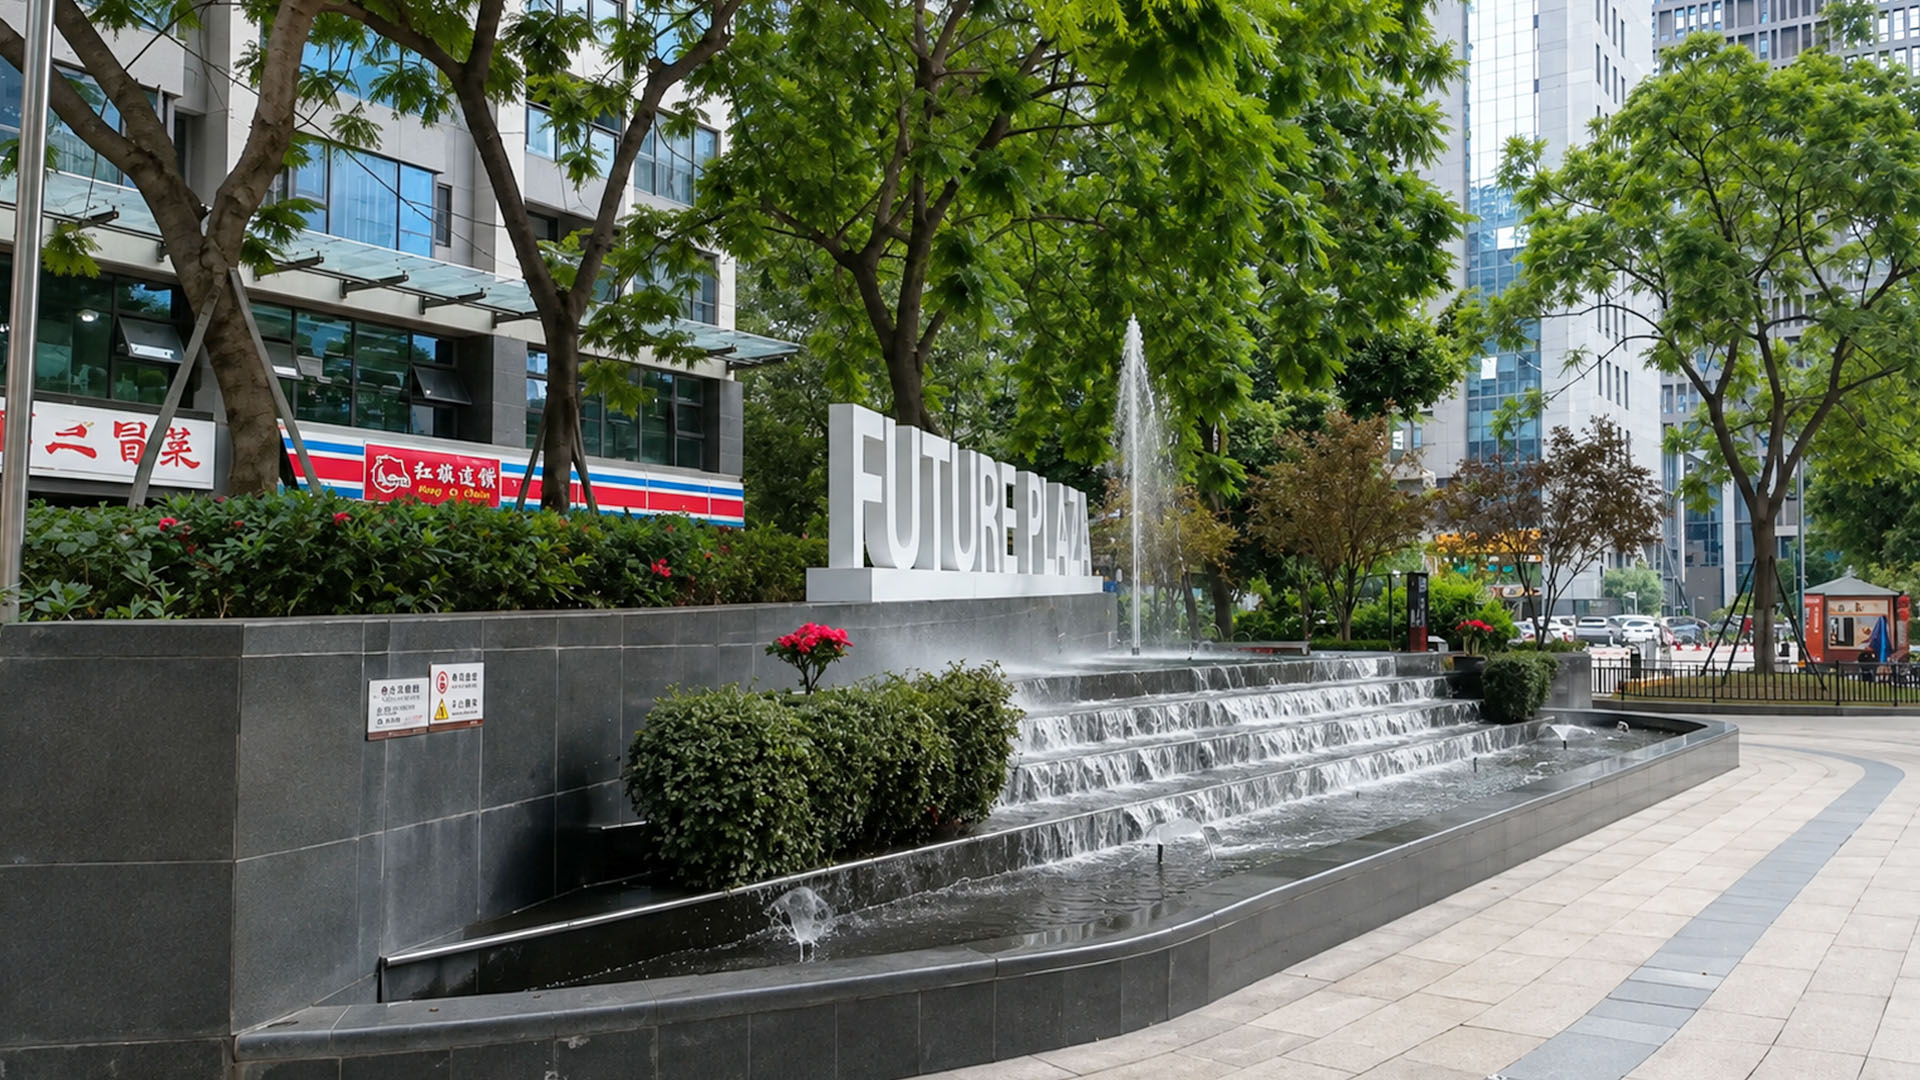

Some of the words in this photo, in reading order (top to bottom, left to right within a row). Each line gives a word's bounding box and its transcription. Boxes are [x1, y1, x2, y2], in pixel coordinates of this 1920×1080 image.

[0, 409, 200, 470] 二冒菜
[829, 403, 1017, 571] FUTURE
[1024, 470, 1093, 576] PLAZA
